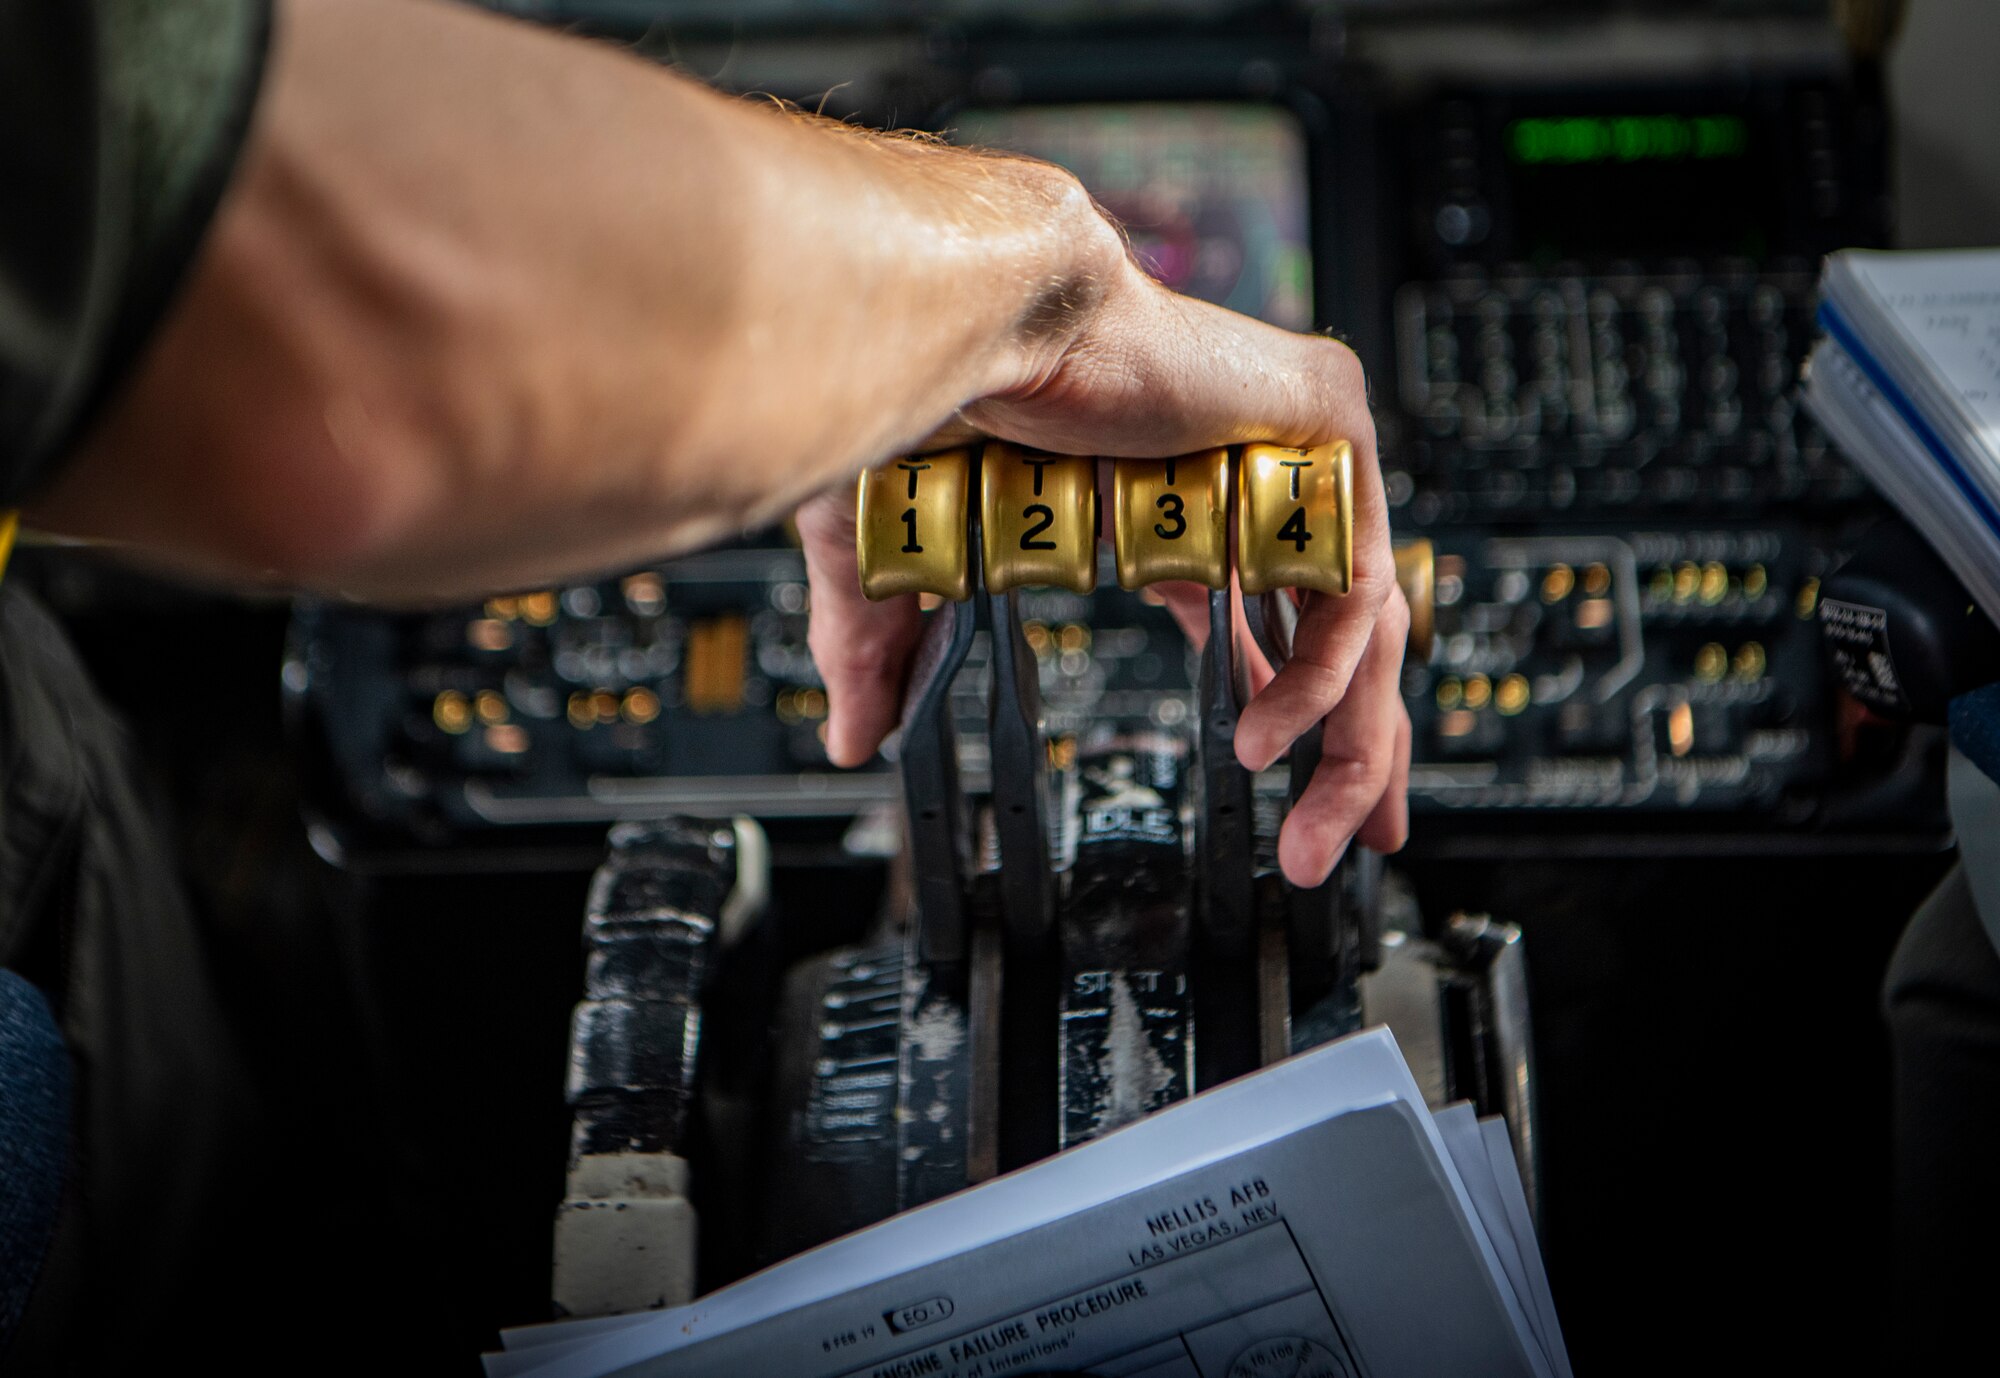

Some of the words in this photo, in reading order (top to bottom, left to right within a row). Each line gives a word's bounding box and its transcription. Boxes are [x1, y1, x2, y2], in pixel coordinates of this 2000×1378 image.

[900, 506, 923, 554] 1
[1019, 503, 1057, 550] 2
[1154, 492, 1187, 541] 3
[1277, 506, 1313, 553] 4
[1086, 808, 1175, 835] IDLE
[1145, 1198, 1219, 1237] NELLIS
[1230, 1178, 1271, 1209] AFB
[1128, 1248, 1166, 1268] LAS
[1167, 1221, 1240, 1254] VEGAS,
[1242, 1201, 1279, 1227] NEV
[902, 1300, 947, 1328] EO-1
[949, 1321, 1032, 1365] FAILURE
[1035, 1277, 1150, 1334] PROCEDURE
[833, 1329, 858, 1350] FEB
